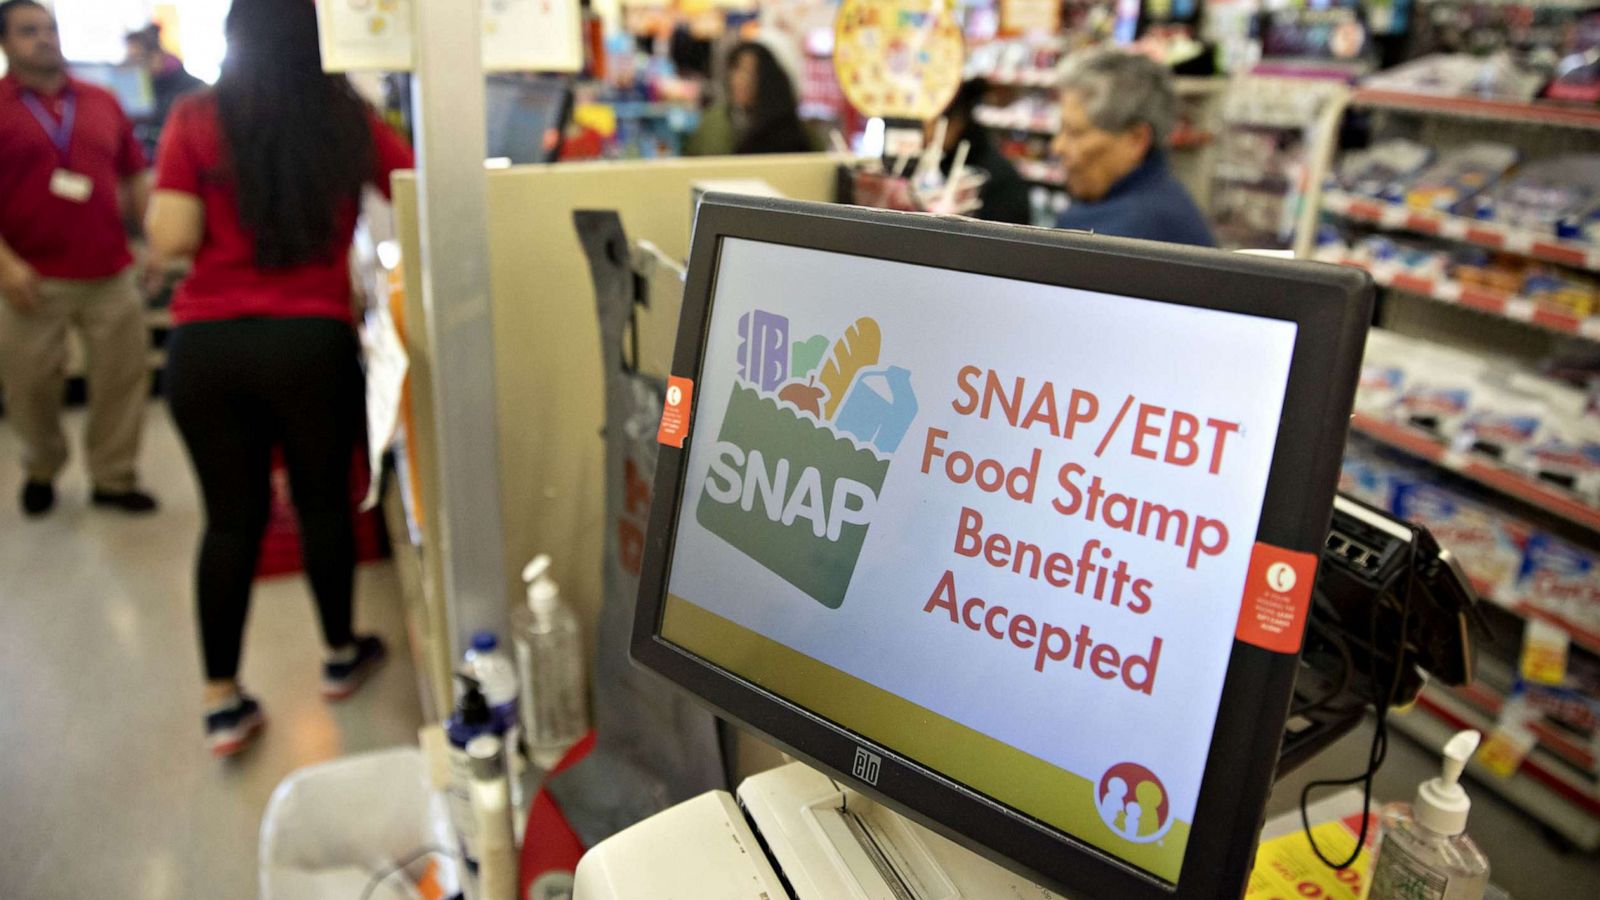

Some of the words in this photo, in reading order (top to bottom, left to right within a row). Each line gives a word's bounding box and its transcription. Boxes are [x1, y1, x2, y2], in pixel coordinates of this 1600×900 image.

[952, 365, 1239, 475] SNAP/EBT
[704, 441, 877, 542] SNAP
[921, 427, 1042, 504] Food
[1052, 462, 1229, 570] Stamp
[954, 506, 1154, 615] Benefits
[922, 570, 1163, 696] Accepted
